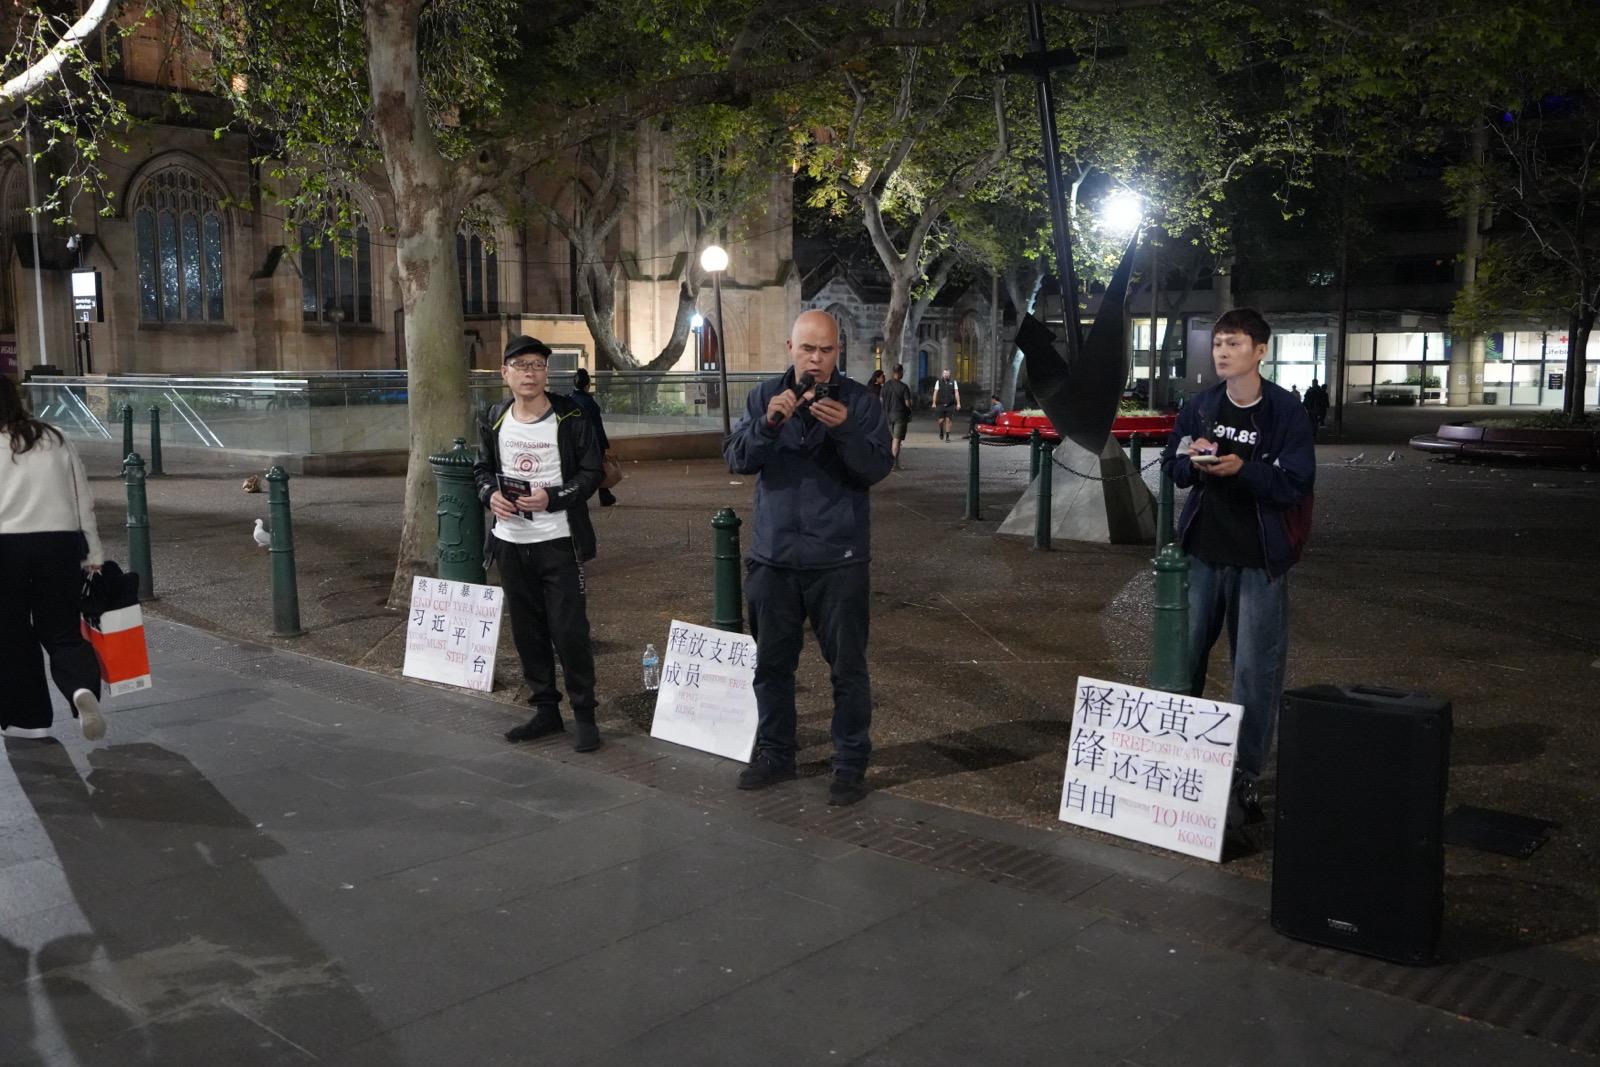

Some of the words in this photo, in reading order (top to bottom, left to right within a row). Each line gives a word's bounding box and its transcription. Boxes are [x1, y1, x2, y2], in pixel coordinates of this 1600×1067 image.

[505, 440, 551, 449] COMPASSION
[418, 579, 495, 601] 终结暴政
[413, 596, 431, 609] END
[433, 599, 450, 613] CCP
[663, 661, 700, 688] 成员
[1076, 685, 1233, 747] 释放黄之
[1111, 732, 1151, 754] FREE
[1192, 747, 1233, 768] WONG
[1072, 728, 1203, 802] 锋还香港
[1065, 778, 1116, 819] 自由
[1152, 804, 1178, 828] TO
[1181, 811, 1217, 829] HONG
